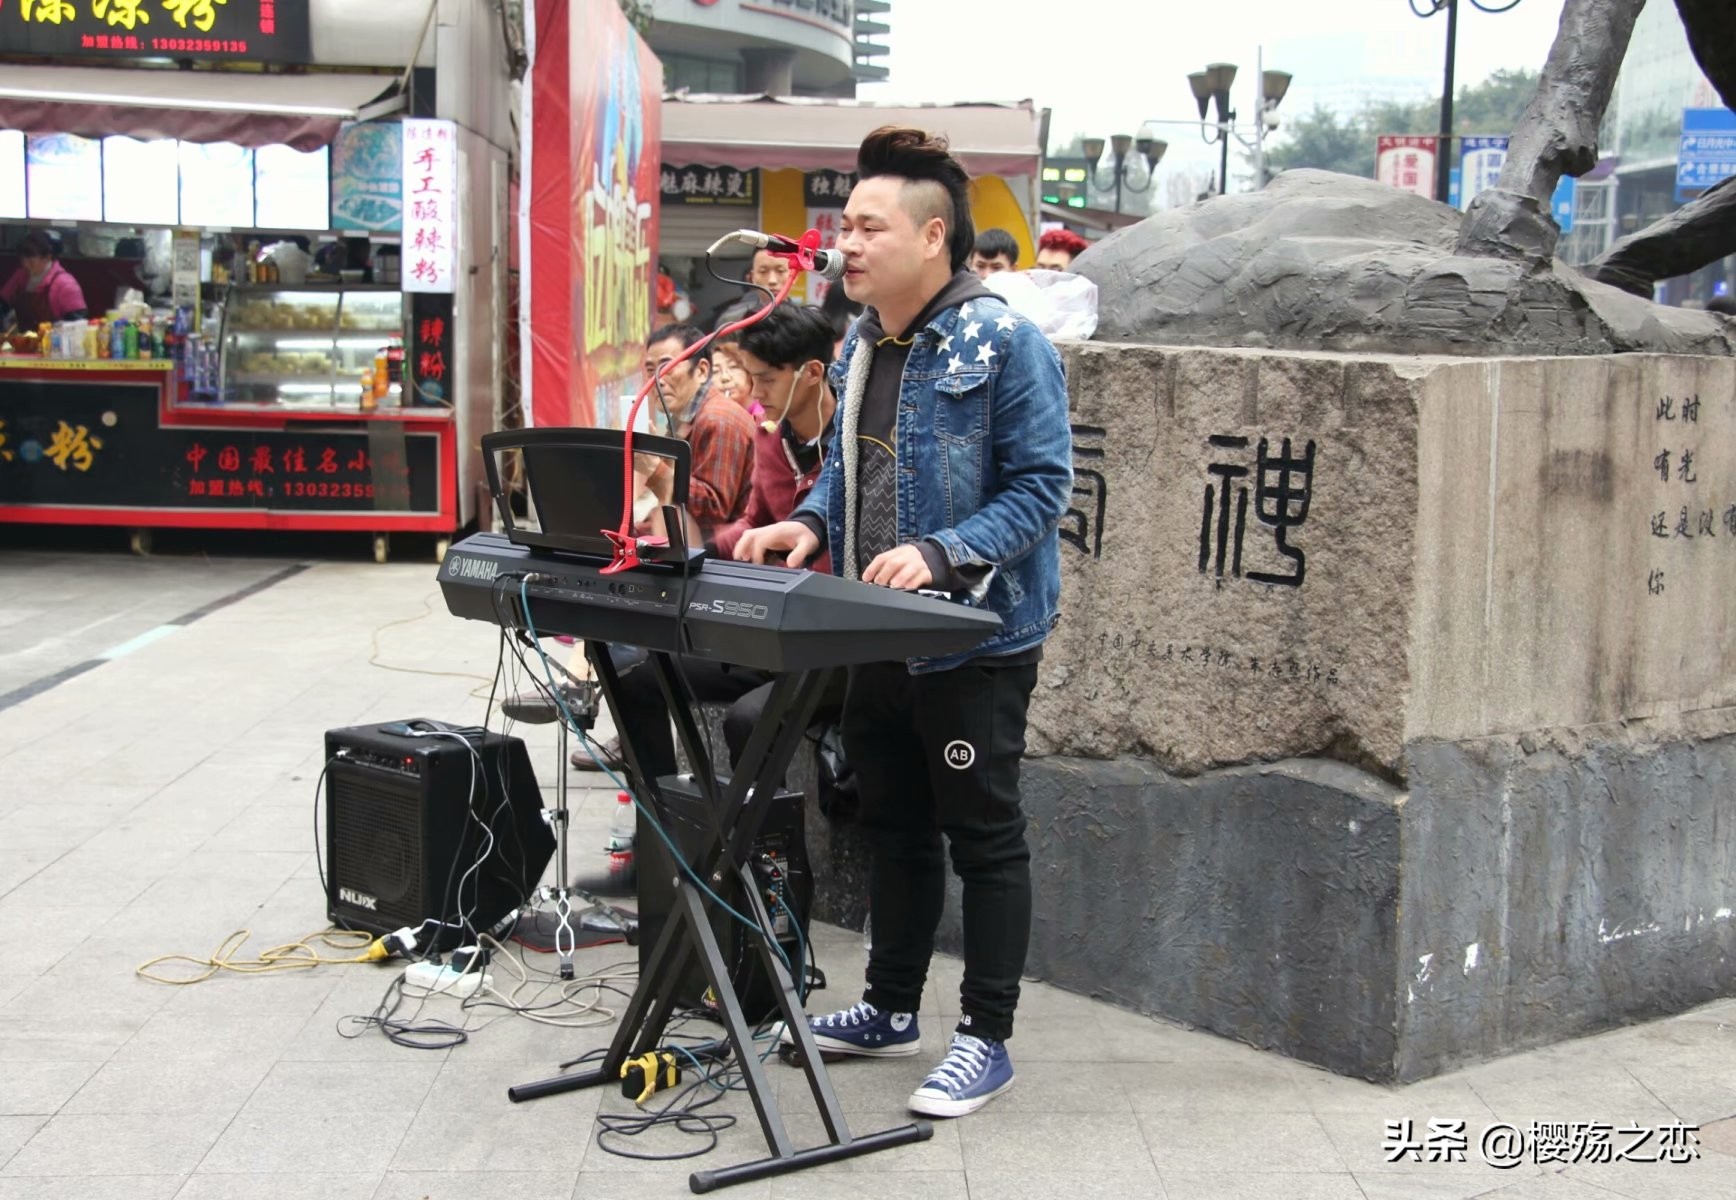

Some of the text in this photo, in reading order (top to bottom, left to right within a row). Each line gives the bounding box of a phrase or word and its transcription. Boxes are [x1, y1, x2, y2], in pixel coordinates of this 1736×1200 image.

[409, 147, 445, 284] 手工酸辣粉
[1655, 394, 1701, 423] 此时
[461, 557, 498, 580] YAMAHA
